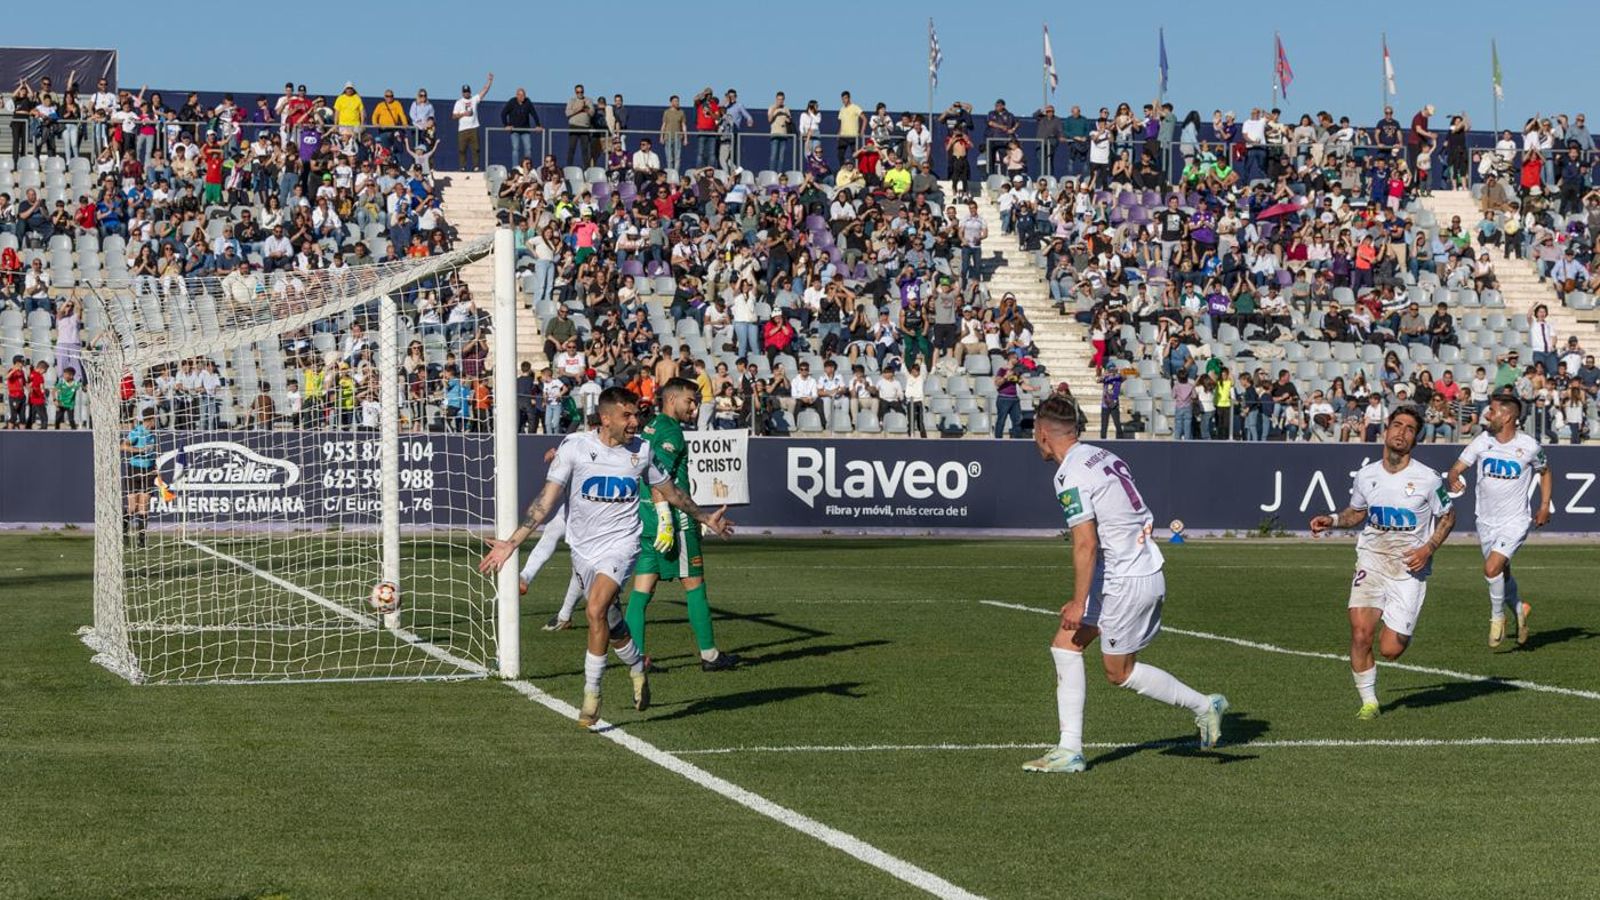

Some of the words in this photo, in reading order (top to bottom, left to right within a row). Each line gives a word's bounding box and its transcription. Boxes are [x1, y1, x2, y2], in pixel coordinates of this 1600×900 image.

[323, 441, 356, 461] 953
[362, 441, 384, 461] 87
[402, 441, 434, 461] 104
[181, 462, 276, 482] uroTaller
[697, 457, 742, 472] CRISTO
[323, 469, 356, 488] 625
[362, 469, 383, 488] 59
[400, 469, 434, 488] 988
[150, 497, 230, 513] TALLERES
[235, 494, 304, 513] CÁMARA
[346, 498, 408, 513] Euro,
[413, 498, 433, 511] 76
[826, 506, 852, 516] Fibra
[853, 508, 861, 518] y
[863, 505, 894, 517] móvil,
[896, 506, 917, 516] más
[918, 508, 944, 516] cerca
[945, 506, 959, 516] de
[960, 506, 968, 516] ti
